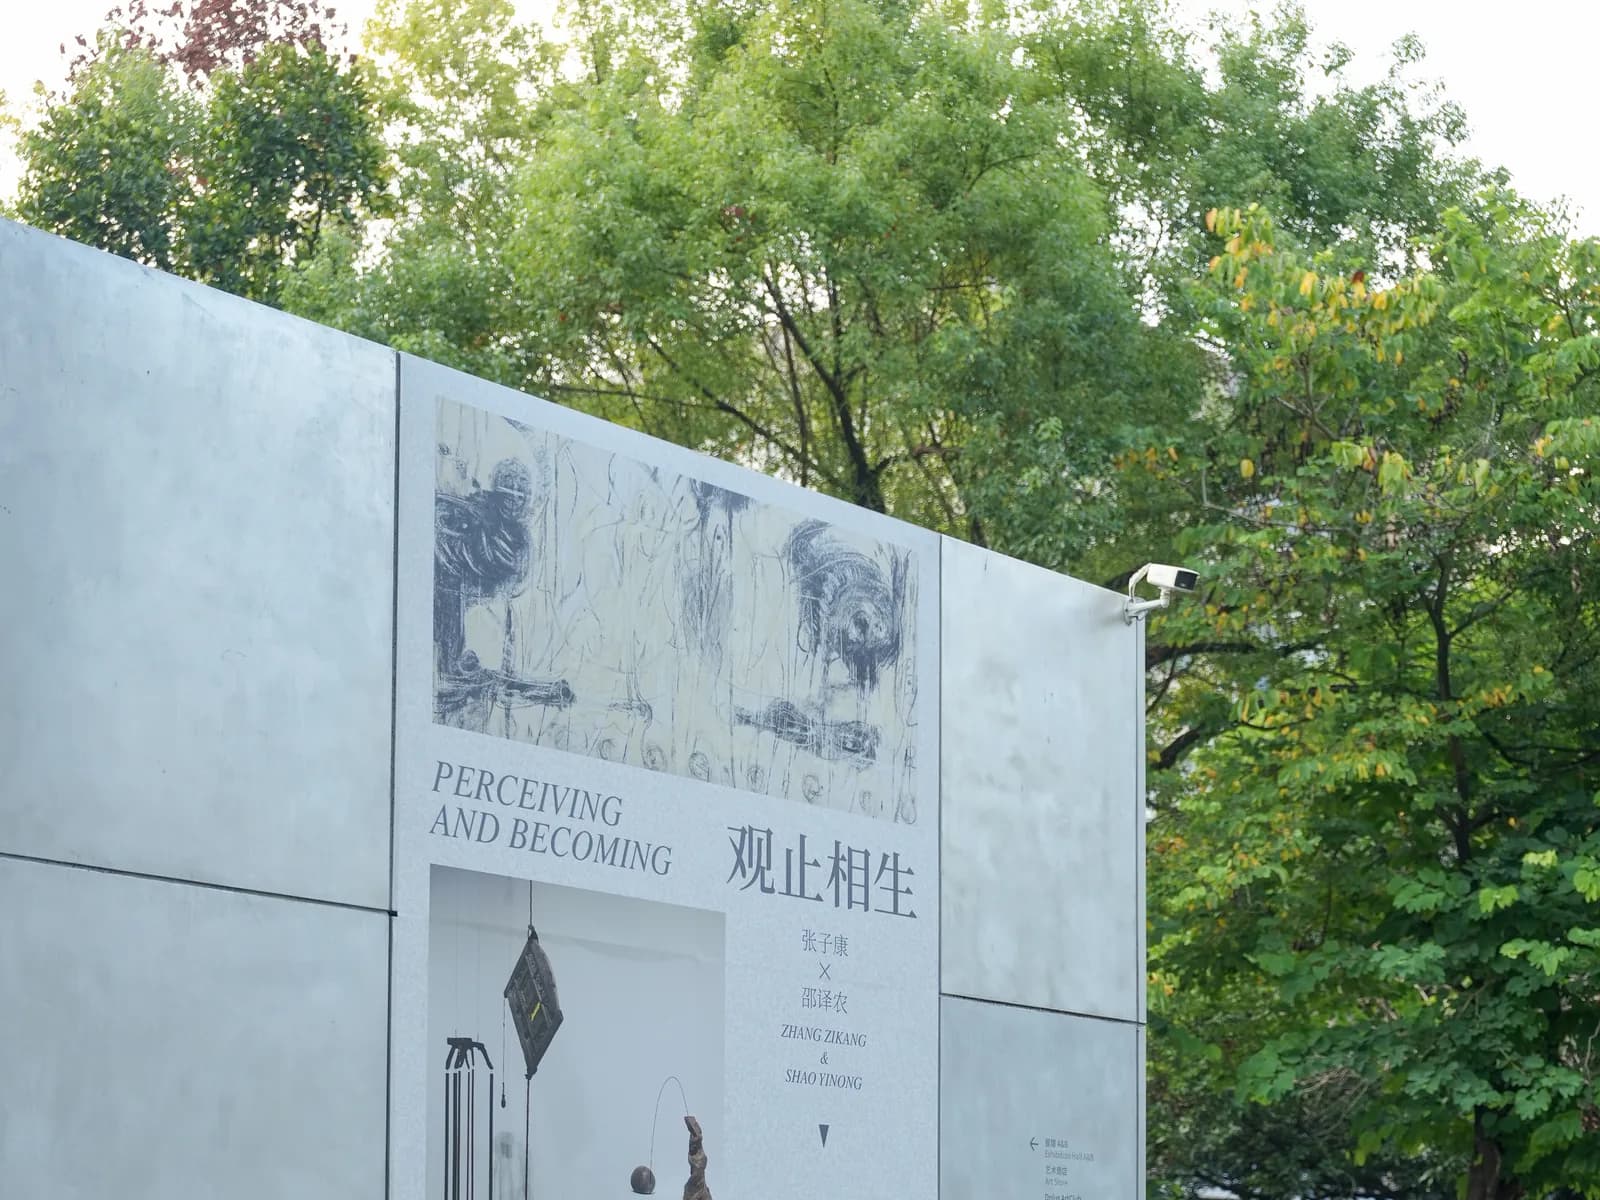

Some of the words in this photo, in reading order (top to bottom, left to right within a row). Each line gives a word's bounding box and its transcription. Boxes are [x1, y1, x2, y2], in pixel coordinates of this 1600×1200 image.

[431, 760, 623, 827] PERCEIVING
[429, 804, 500, 845] AND
[508, 818, 673, 876] BECOMING
[725, 824, 919, 920] 观止相生
[801, 928, 849, 957] 张子康
[801, 986, 848, 1014] 邵译农
[780, 1024, 822, 1042] ZHANG
[823, 1029, 867, 1047] ZIKANG
[820, 1052, 829, 1065] &
[785, 1068, 817, 1085] SHAO
[819, 1073, 863, 1090] YINONG
